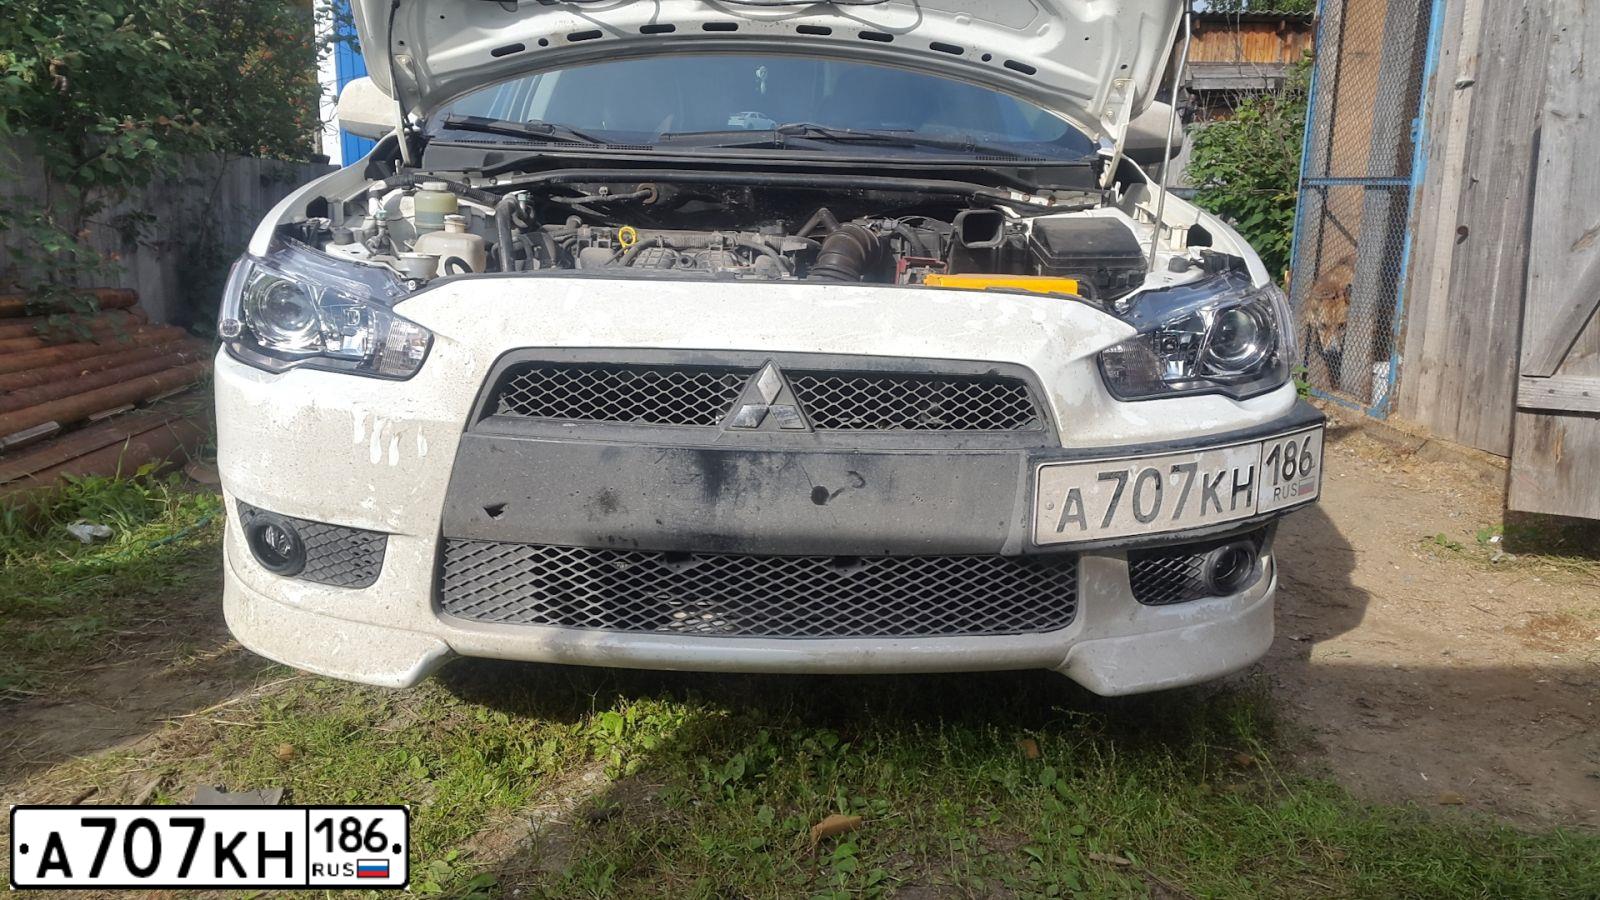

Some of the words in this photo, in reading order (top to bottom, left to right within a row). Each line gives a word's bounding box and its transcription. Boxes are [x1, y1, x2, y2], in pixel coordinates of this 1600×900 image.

[1056, 461, 1254, 533] A707KH
[1265, 435, 1313, 486] 186
[1273, 483, 1298, 502] RUS
